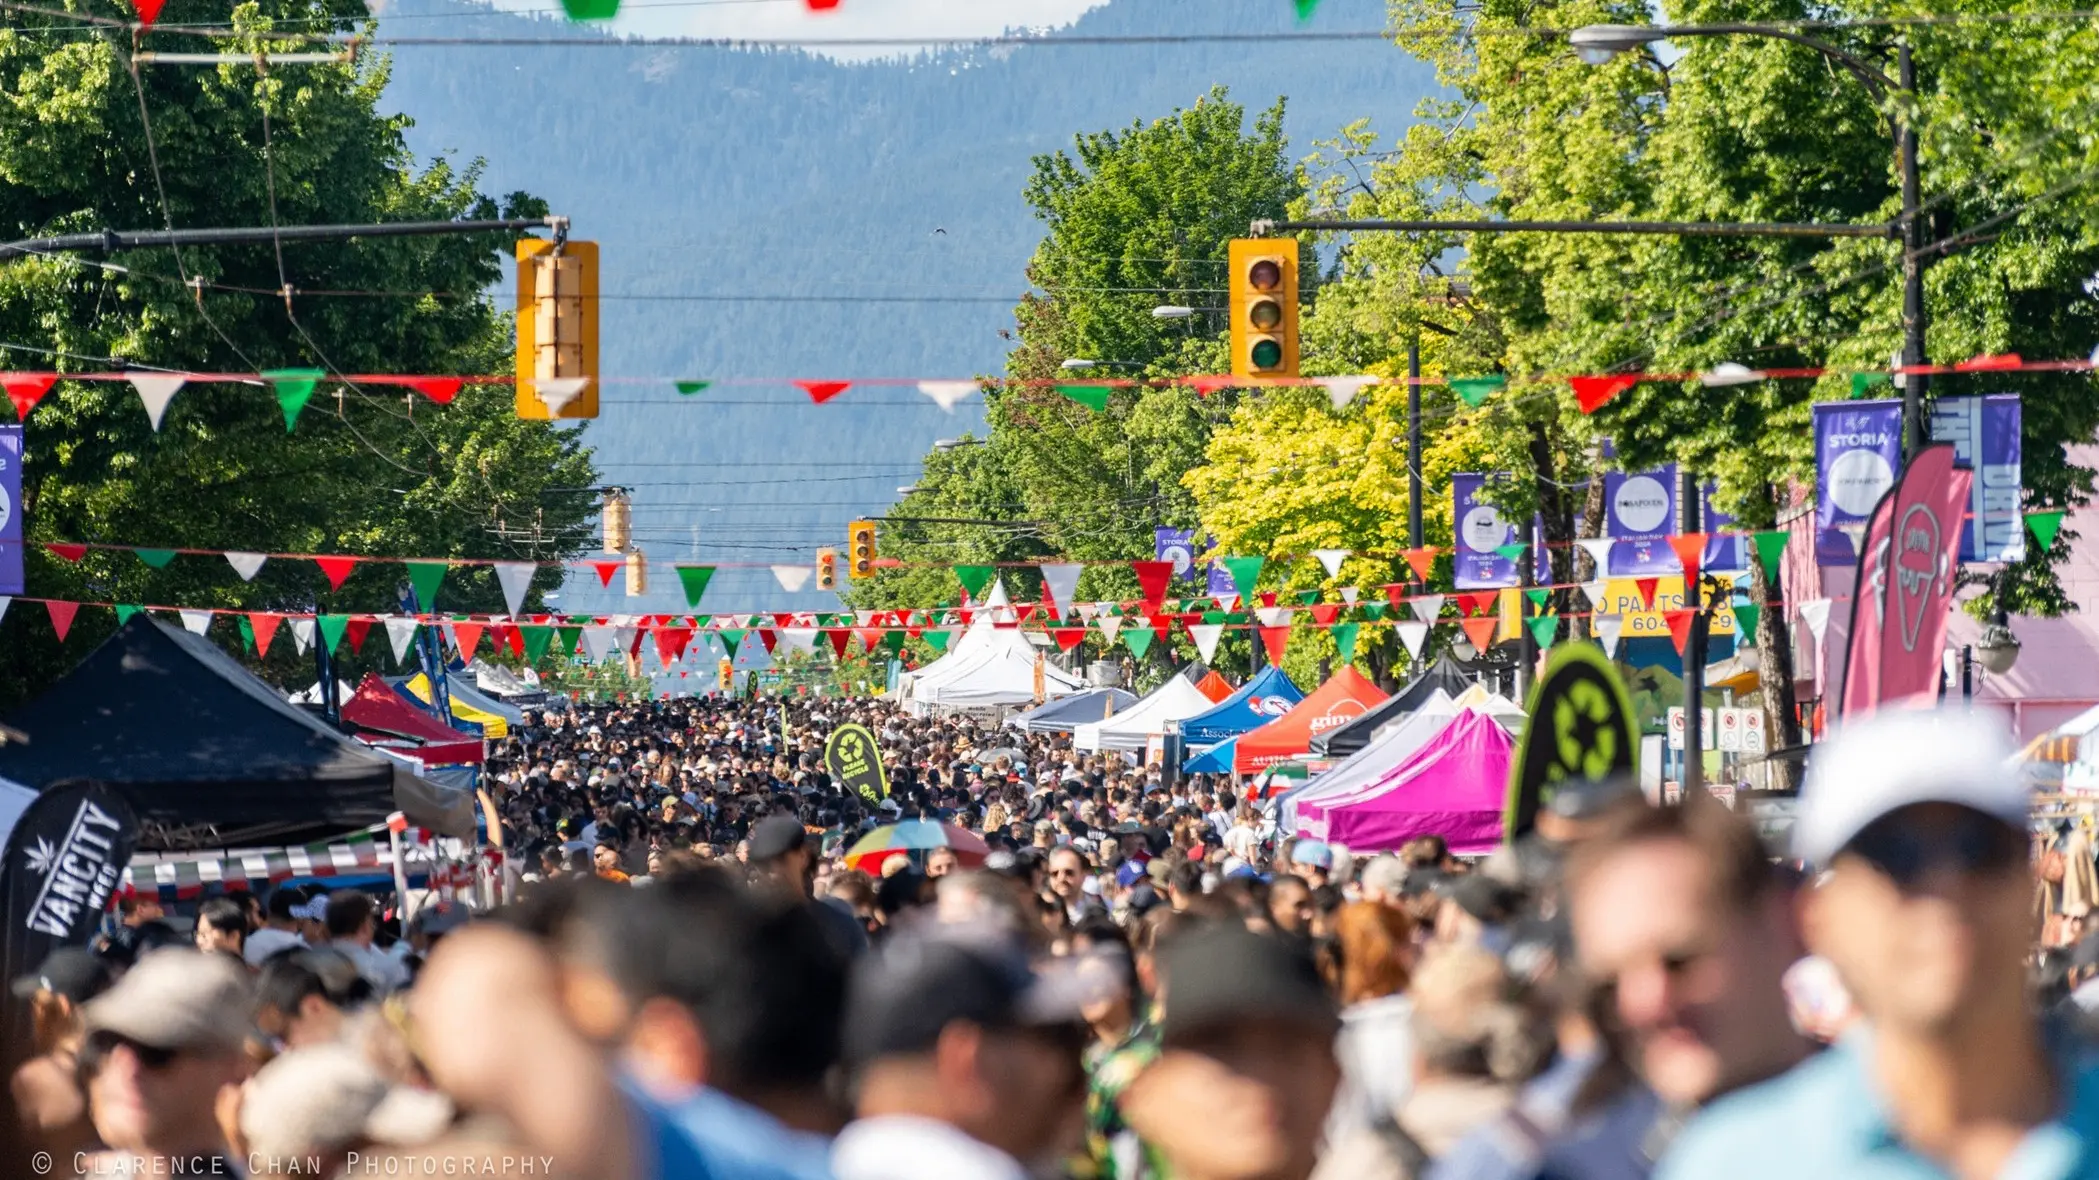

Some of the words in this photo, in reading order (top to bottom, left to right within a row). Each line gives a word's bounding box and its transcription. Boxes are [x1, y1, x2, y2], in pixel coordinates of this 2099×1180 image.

[1829, 432, 1889, 448] STORIA
[842, 758, 865, 773] PLEASE
[842, 764, 869, 780] RECYCLE
[33, 801, 121, 938] VANCITY
[89, 863, 119, 910] WEED
